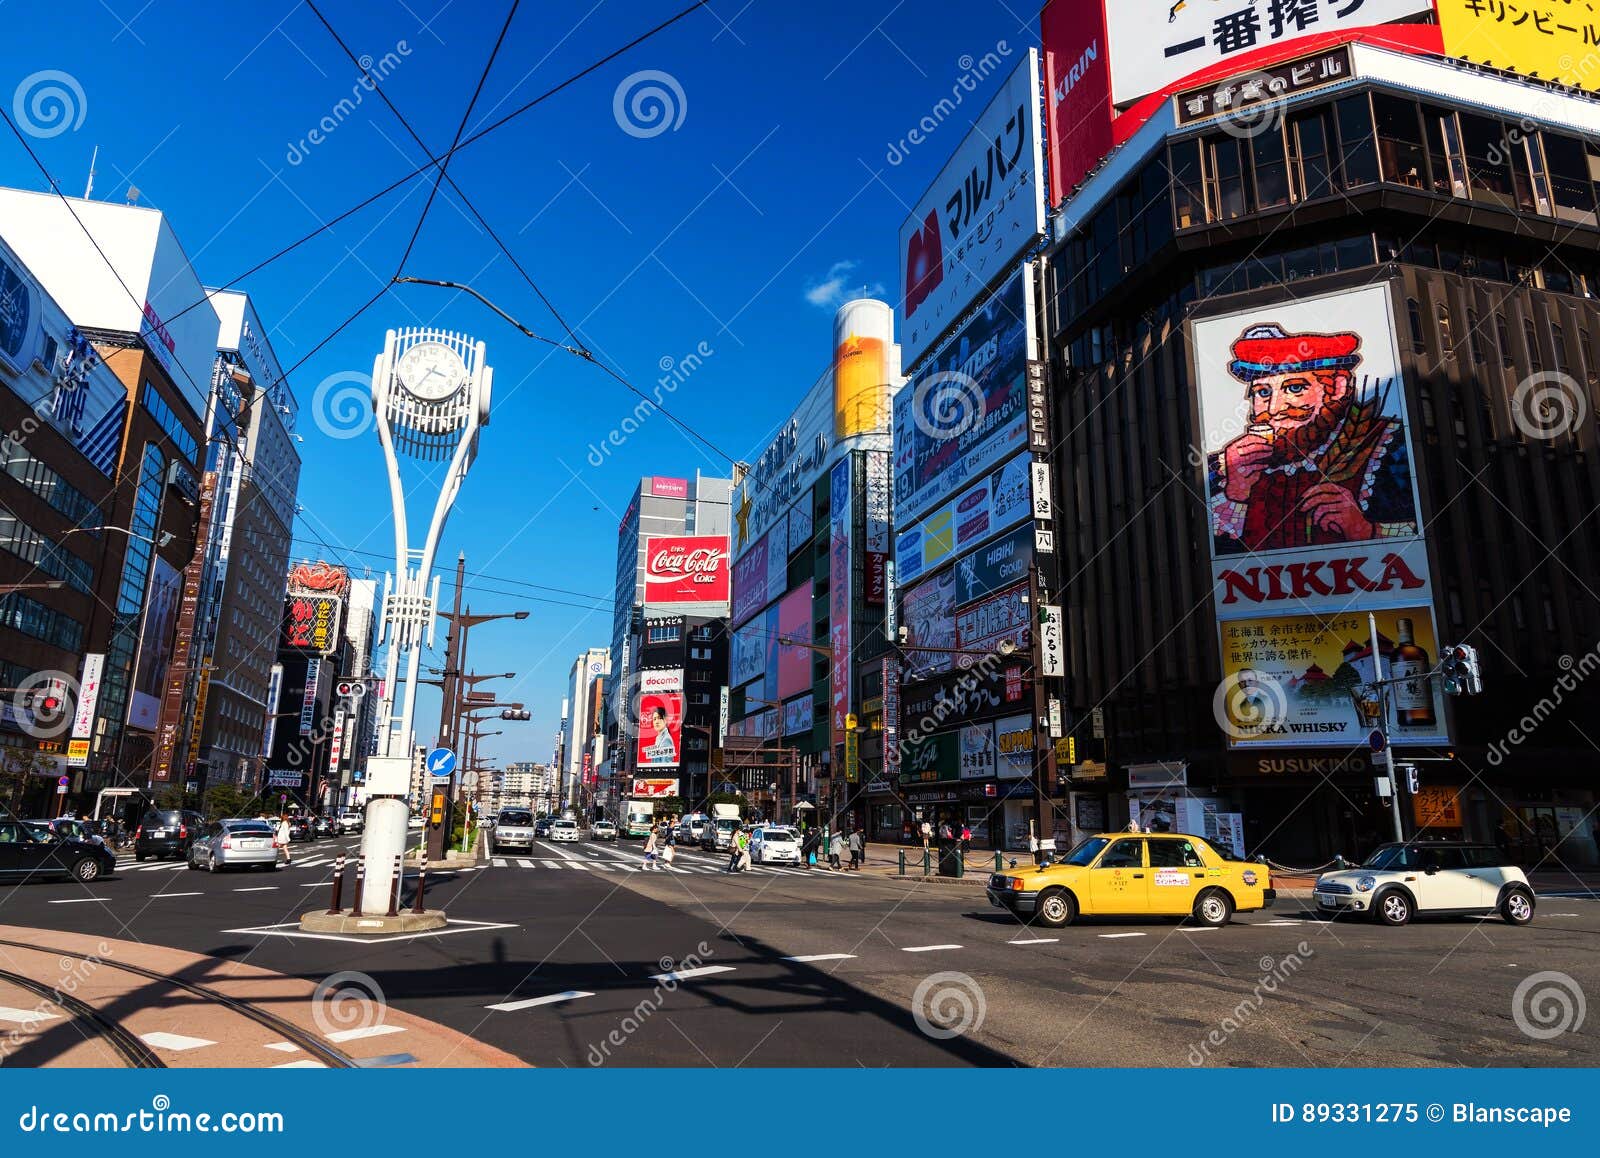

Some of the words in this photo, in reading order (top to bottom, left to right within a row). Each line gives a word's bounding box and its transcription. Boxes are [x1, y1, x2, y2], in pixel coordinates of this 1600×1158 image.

[1465, 0, 1600, 46] キリンビール
[1054, 39, 1097, 108] KIRIN
[945, 104, 1025, 241] マルハン
[652, 548, 721, 574] Coca-Cola
[738, 544, 764, 583] カラオケ
[986, 539, 1015, 567] HIBIKI
[693, 573, 716, 584] Coke
[871, 552, 885, 596] カラオケ
[999, 558, 1023, 578] Group
[1217, 553, 1426, 605] NIKKA
[1228, 626, 1265, 638] 北海道
[646, 676, 679, 686] docomo
[1237, 723, 1288, 735] NIKKA
[1290, 722, 1347, 734] WHISKY
[1258, 758, 1366, 774] SUSUKINO
